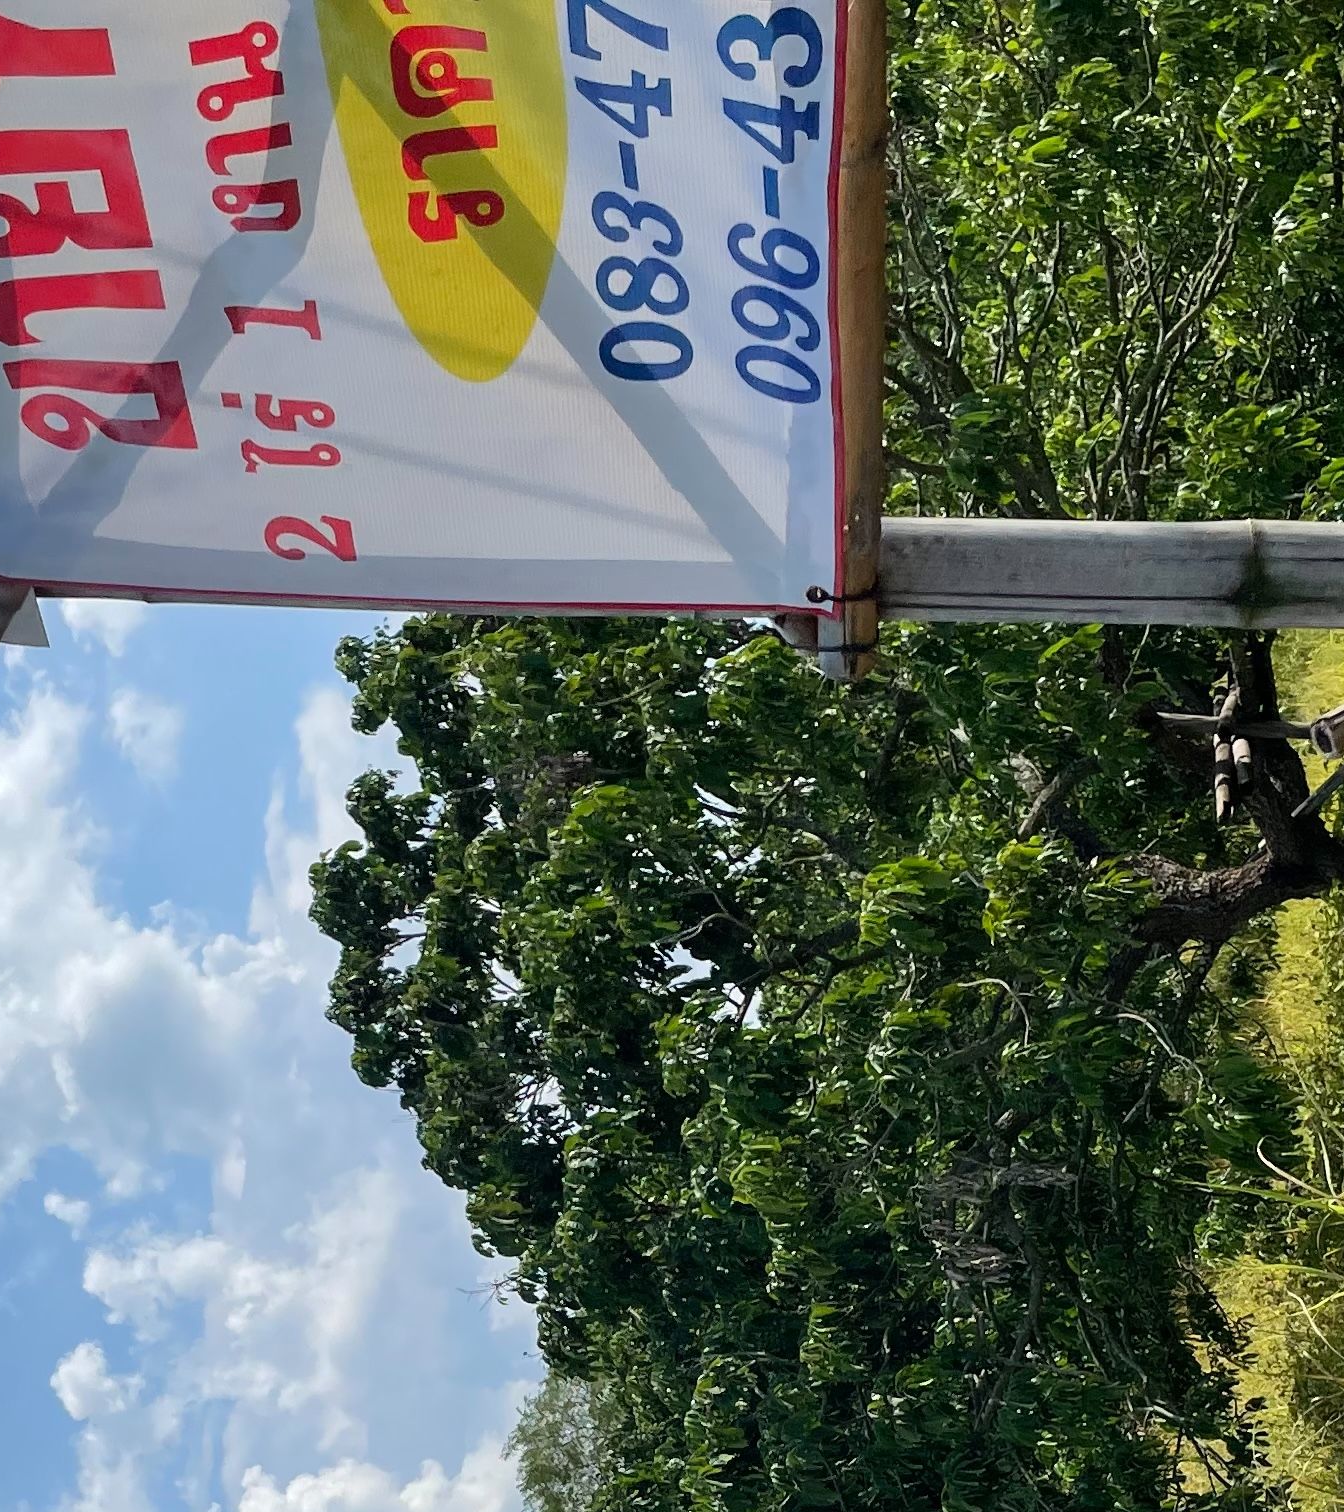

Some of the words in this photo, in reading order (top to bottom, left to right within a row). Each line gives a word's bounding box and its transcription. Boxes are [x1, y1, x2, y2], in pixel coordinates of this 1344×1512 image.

[187, 19, 302, 233] งาน
[566, 0, 695, 382] 083-47
[715, 5, 824, 406] 096-43
[222, 299, 323, 341] 1
[220, 391, 343, 474] ไร่
[263, 514, 357, 562] 2
